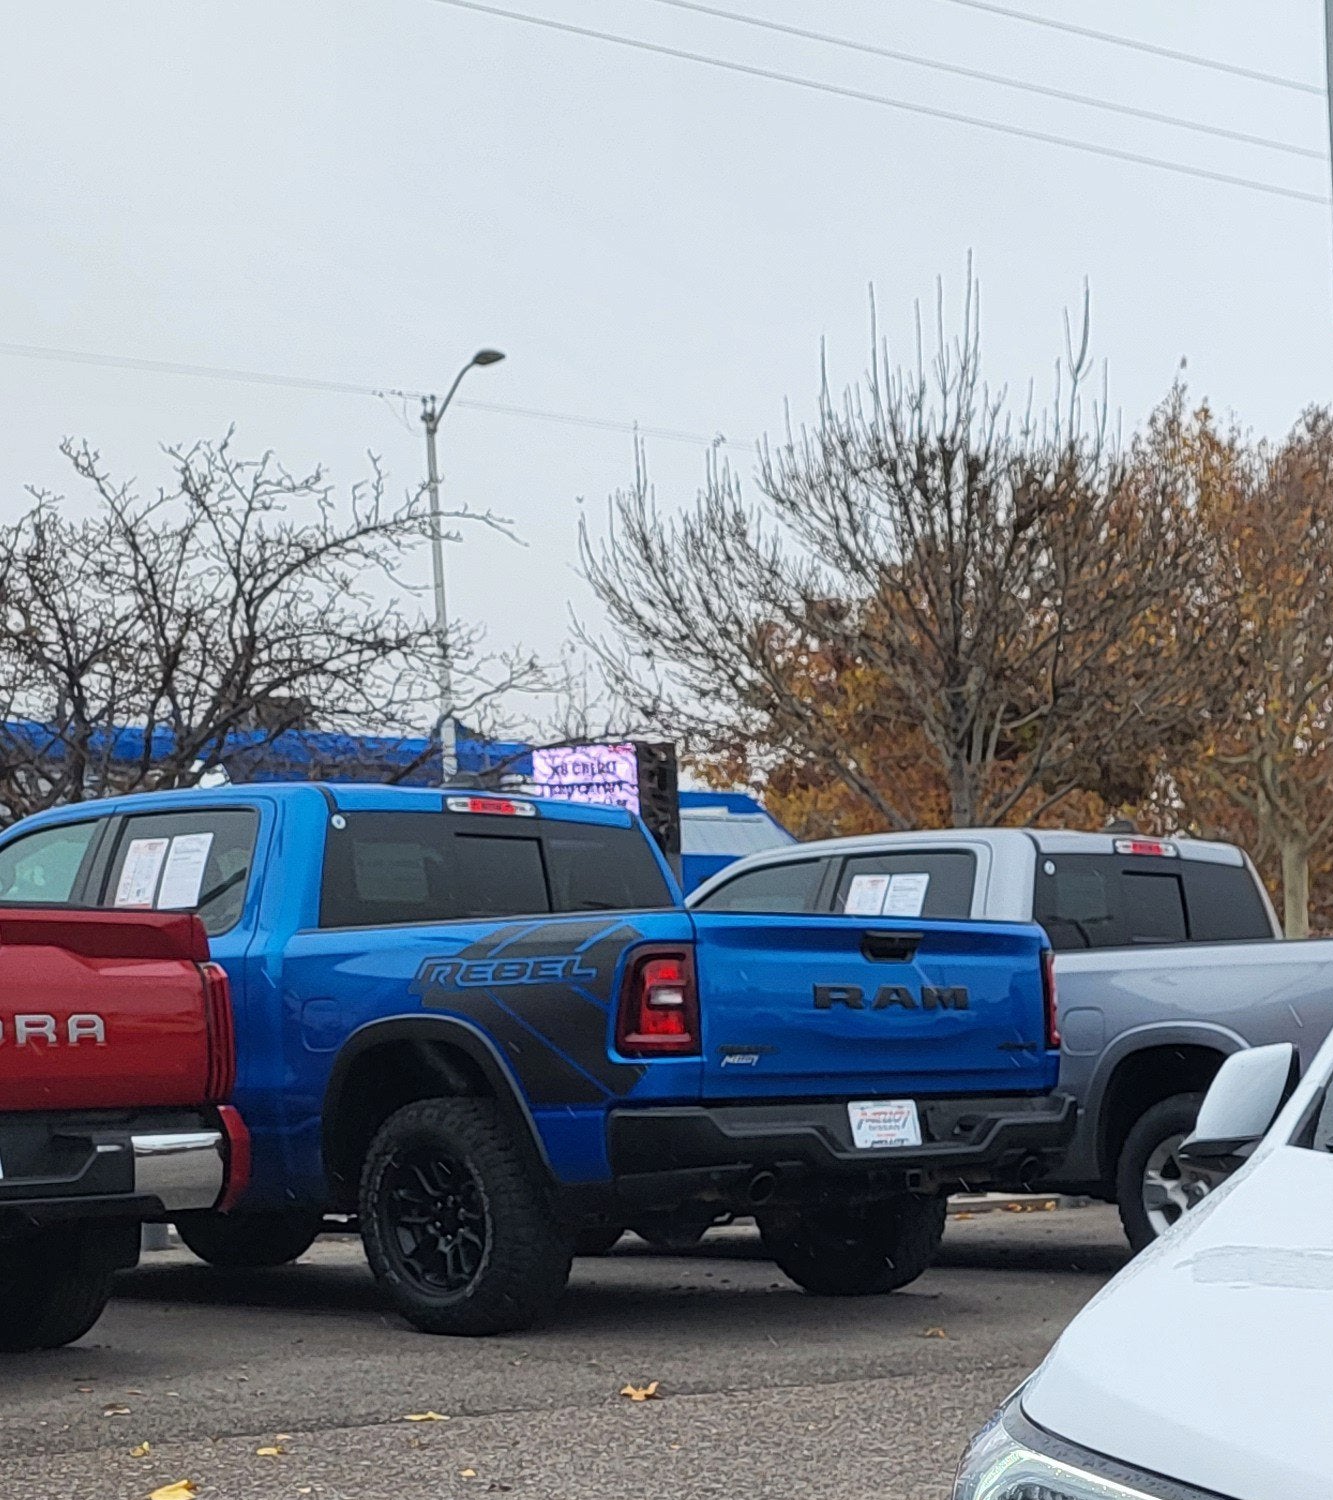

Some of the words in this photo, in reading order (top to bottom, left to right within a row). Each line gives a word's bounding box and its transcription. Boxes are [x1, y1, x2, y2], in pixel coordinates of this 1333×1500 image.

[418, 956, 598, 988] REBEL
[813, 983, 971, 1011] RAM
[0, 1013, 105, 1045] RA
